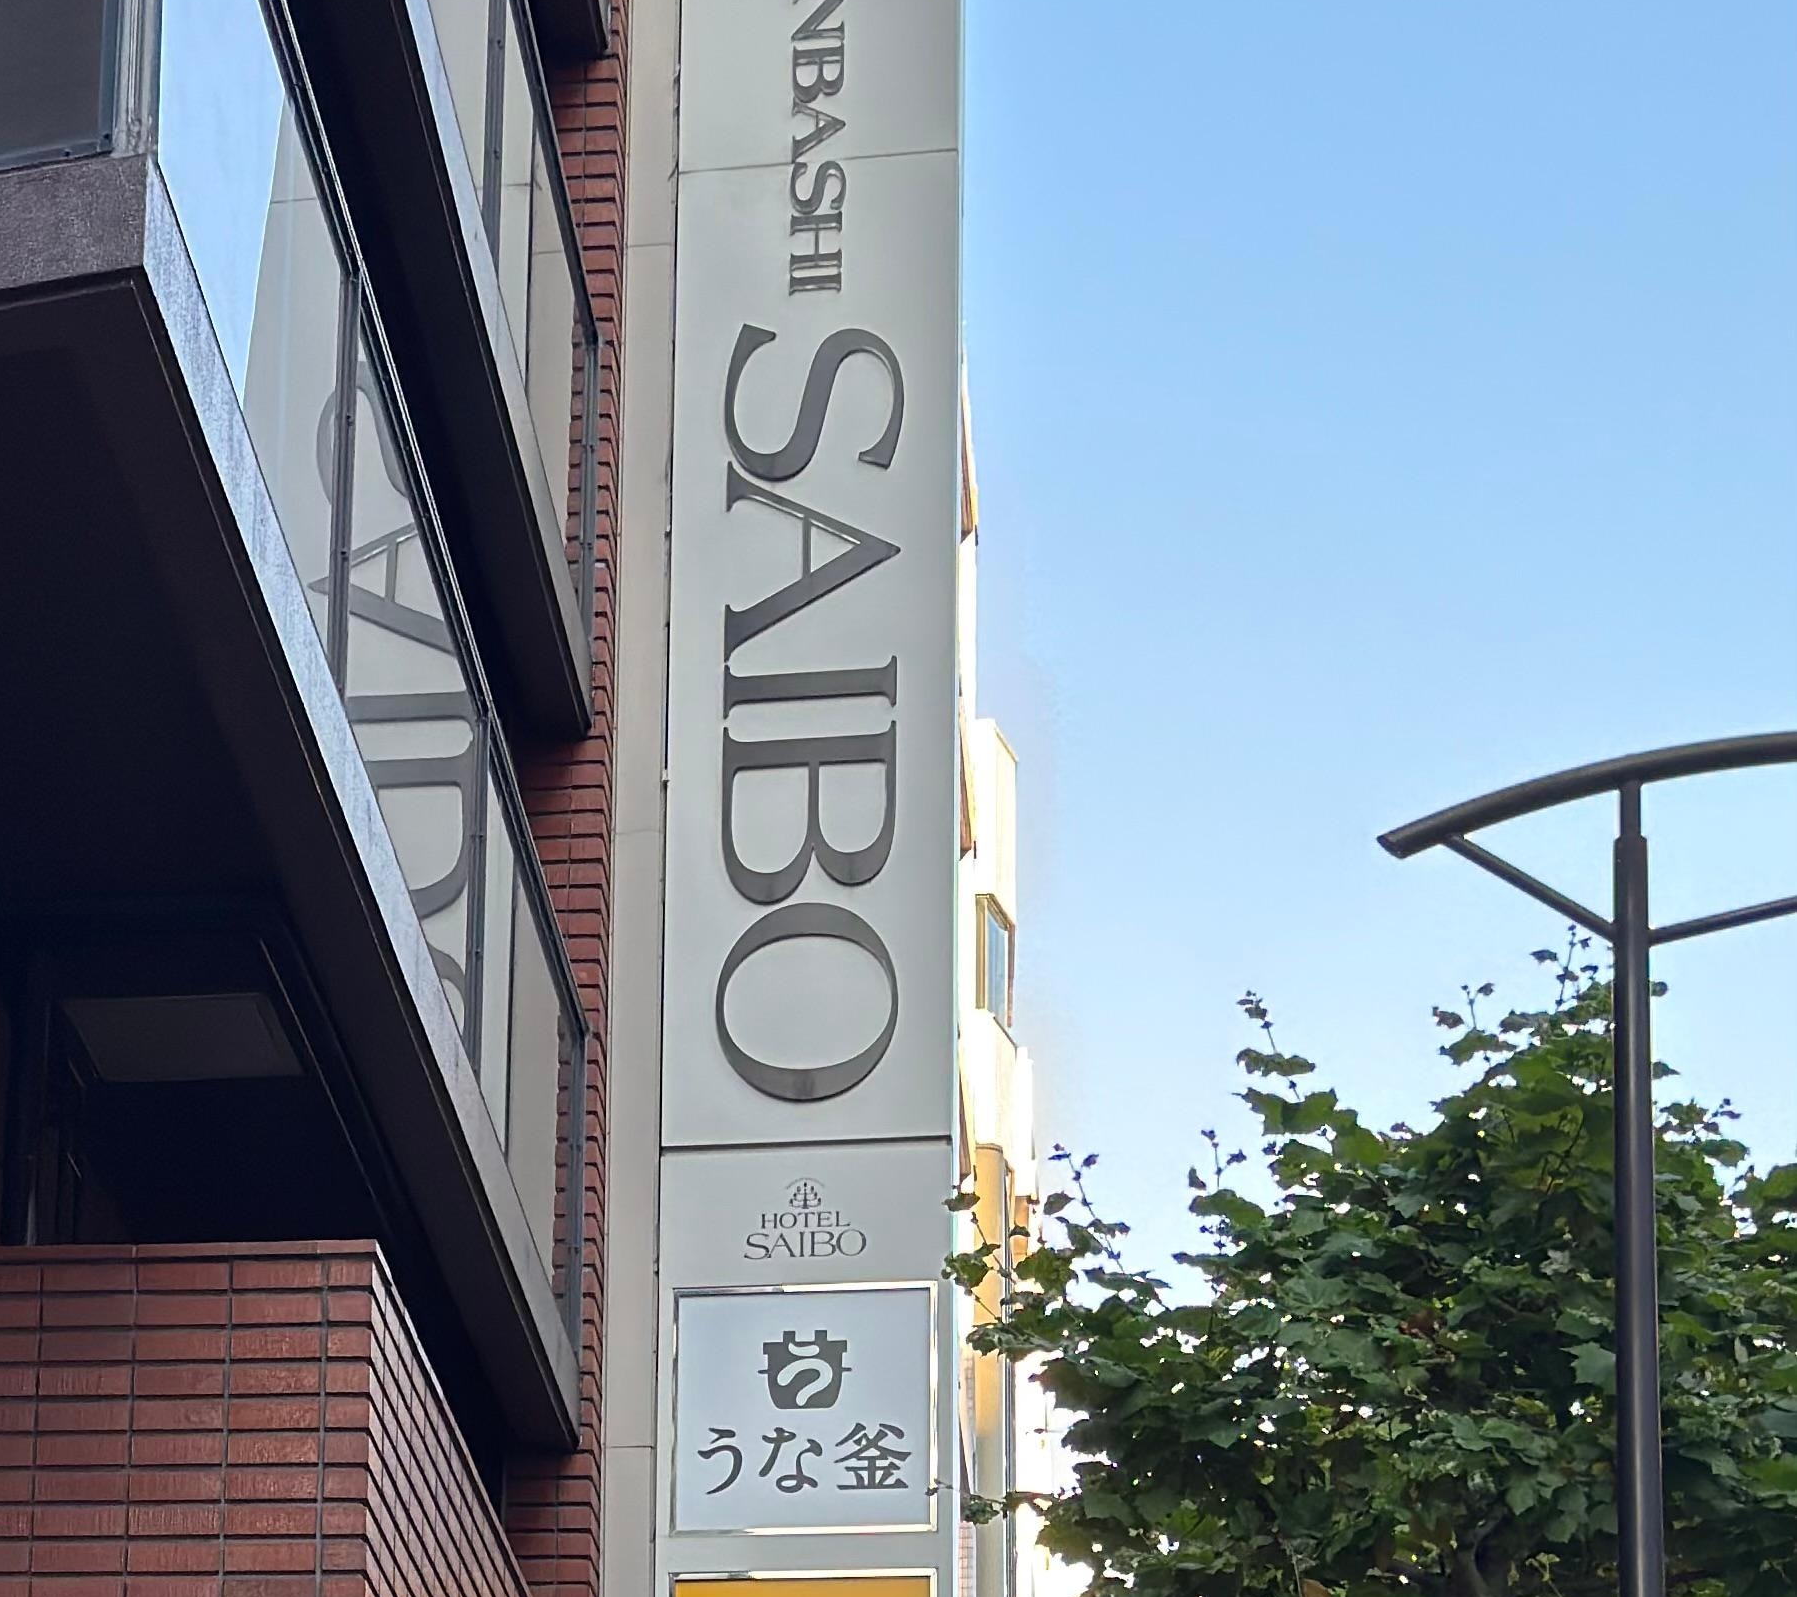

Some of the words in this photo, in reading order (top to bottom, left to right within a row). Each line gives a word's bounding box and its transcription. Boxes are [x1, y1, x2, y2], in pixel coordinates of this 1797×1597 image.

[716, 323, 907, 1102] SAIBO
[743, 1229, 867, 1260] SAIBO
[760, 1210, 851, 1230] HOTEL
[697, 1422, 913, 1495] うな釜
